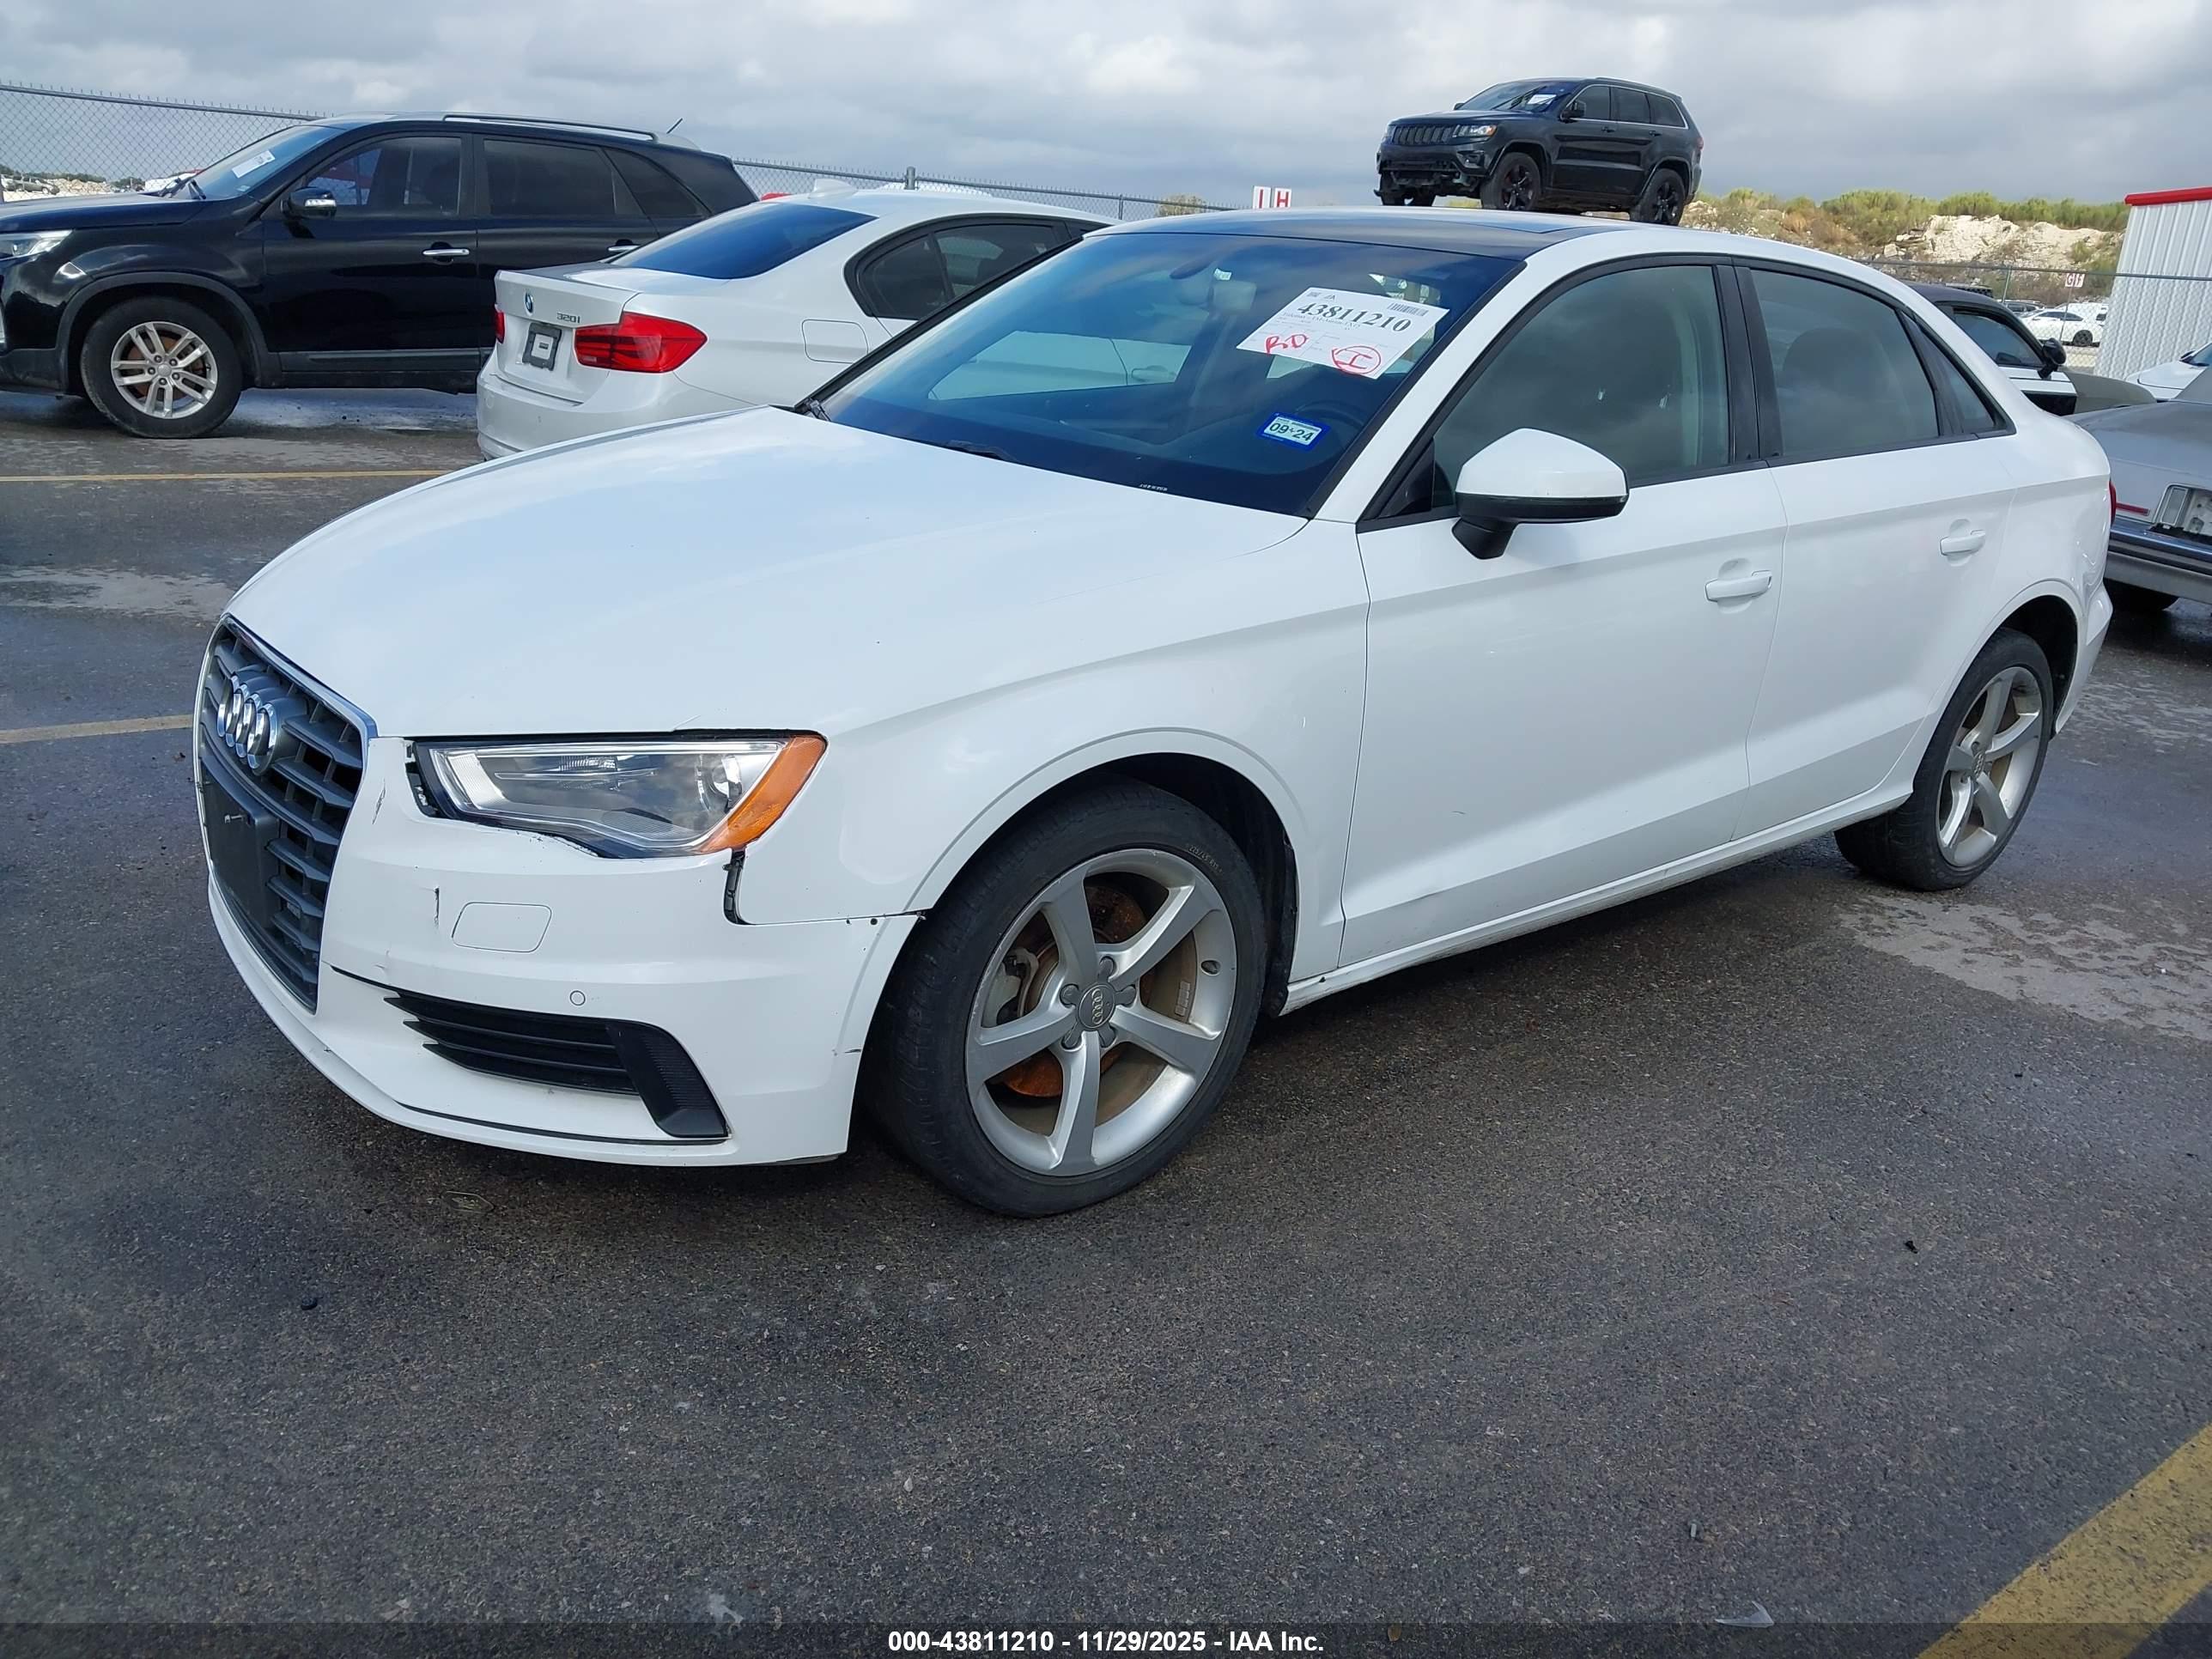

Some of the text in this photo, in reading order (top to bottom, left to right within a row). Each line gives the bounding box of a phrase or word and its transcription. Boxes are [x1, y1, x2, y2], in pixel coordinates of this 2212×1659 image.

[1297, 302, 1412, 332] 43811210
[1269, 422, 1290, 434] 09
[1291, 428, 1315, 441] 24
